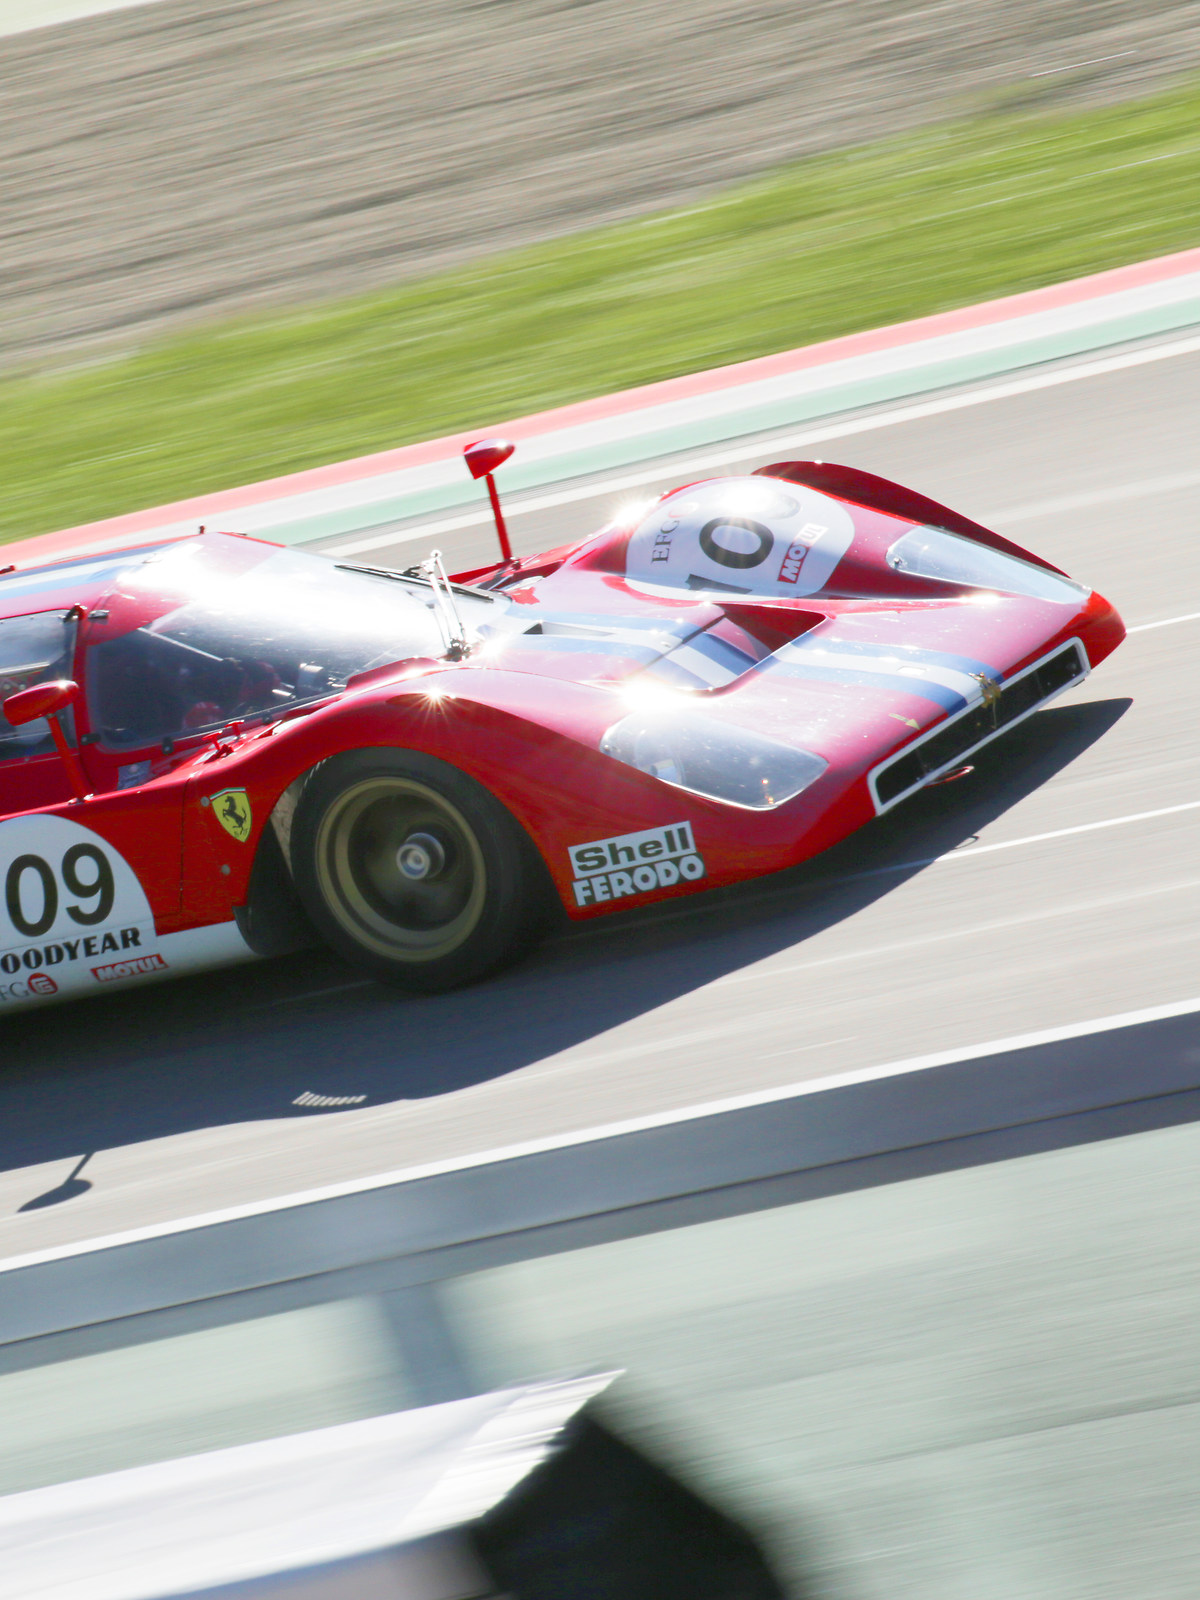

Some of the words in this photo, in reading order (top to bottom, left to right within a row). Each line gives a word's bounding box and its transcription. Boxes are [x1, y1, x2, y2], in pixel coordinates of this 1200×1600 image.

[574, 827, 691, 872] Shell
[572, 854, 705, 907] FERODO
[95, 955, 168, 981] MOTUL
